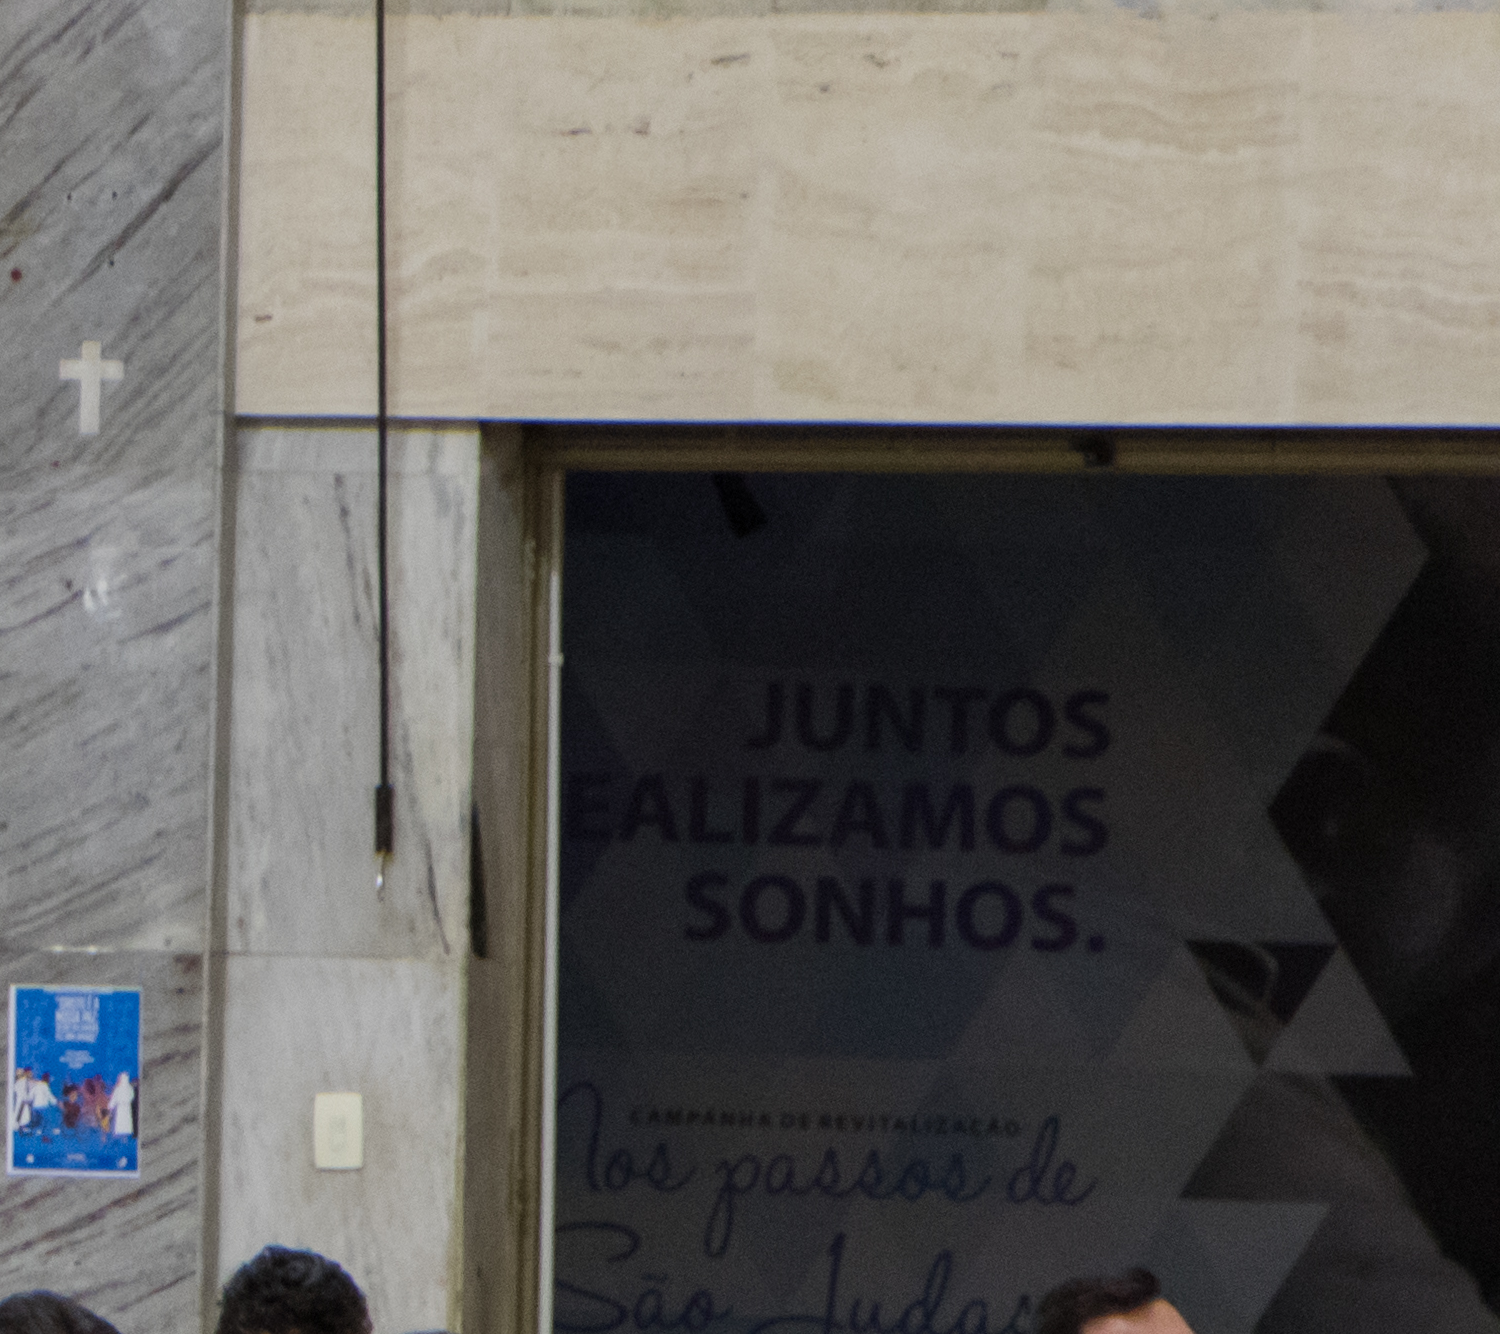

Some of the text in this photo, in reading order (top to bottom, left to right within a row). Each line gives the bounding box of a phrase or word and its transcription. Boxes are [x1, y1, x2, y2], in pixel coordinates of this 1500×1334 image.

[744, 681, 1111, 760] JUNTOS
[564, 771, 1110, 857] EALIZAMOS
[684, 871, 1107, 954] SONHOS.
[780, 1111, 810, 1132] DE
[818, 1110, 1021, 1139] REVITALIZAÇÃO
[702, 1143, 993, 1258] passos
[1006, 1114, 1098, 1207] de
[555, 1220, 733, 1334] São
